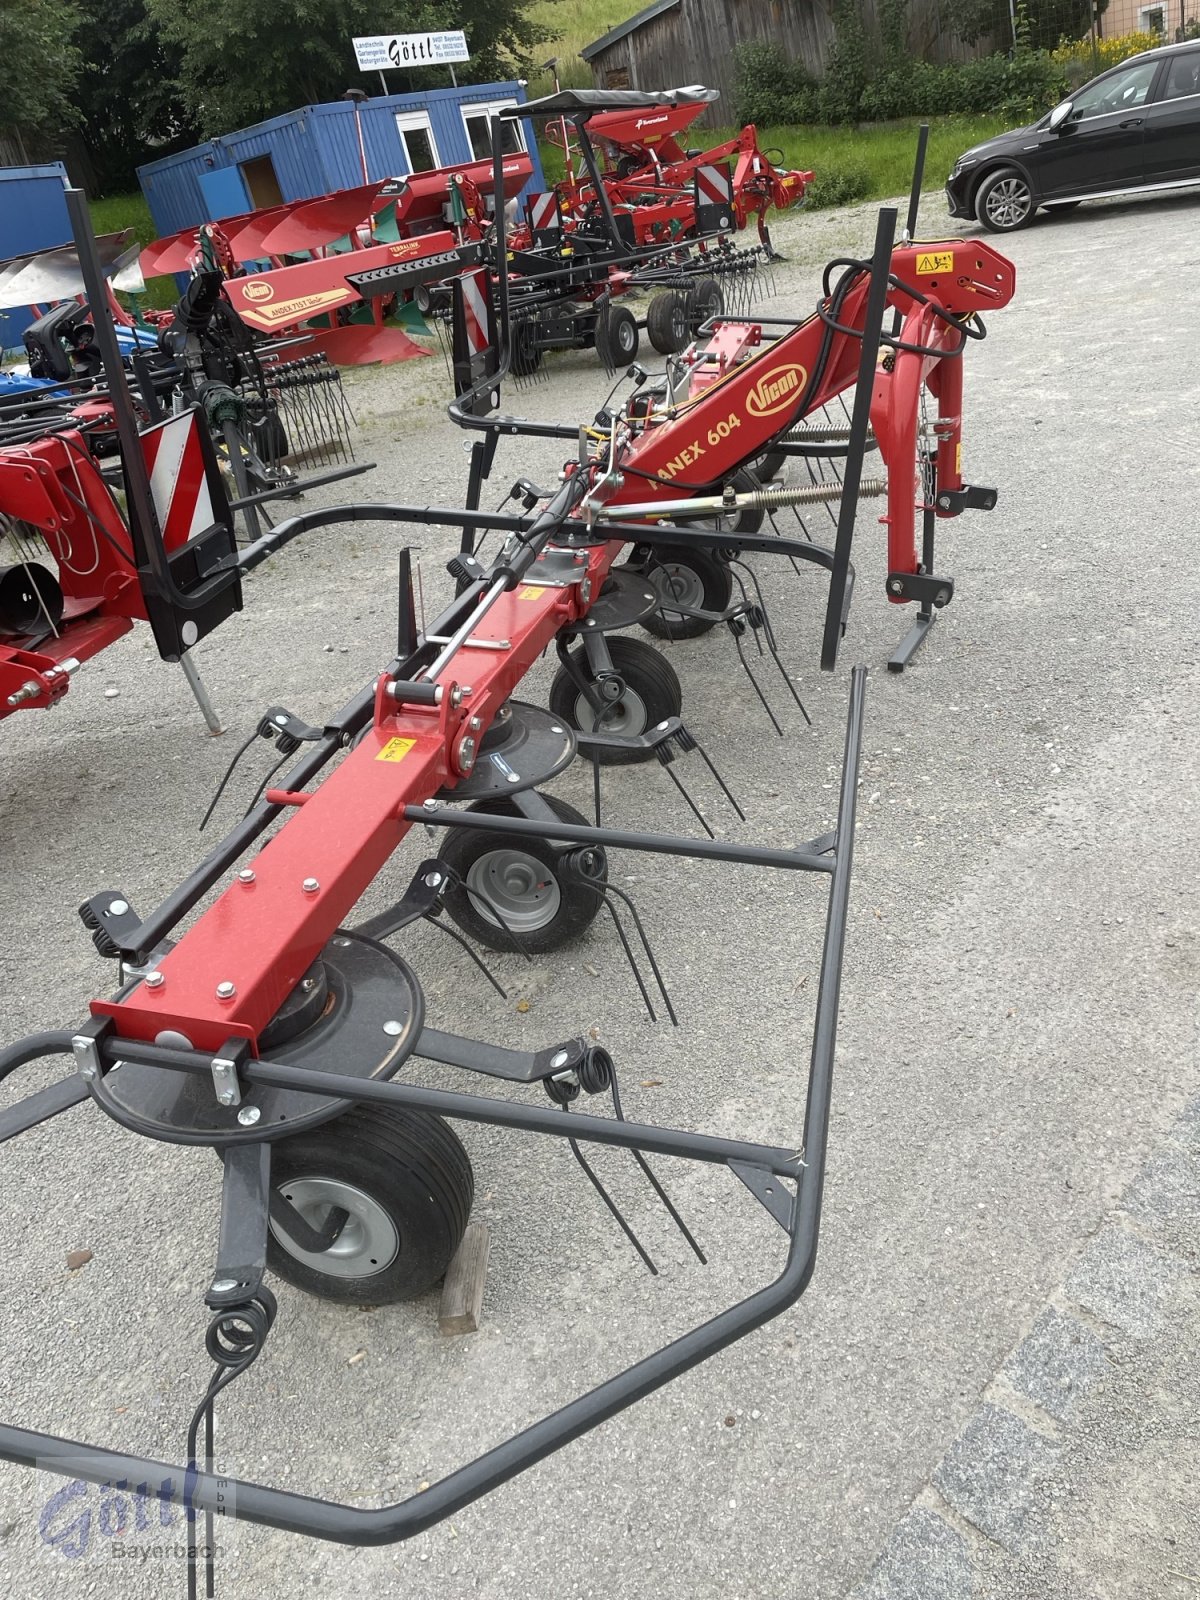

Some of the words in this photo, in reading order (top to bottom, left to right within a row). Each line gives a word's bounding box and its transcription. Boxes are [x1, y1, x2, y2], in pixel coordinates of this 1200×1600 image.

[358, 49, 386, 57] Gartengeräte
[388, 37, 433, 66] Göttl
[246, 282, 270, 298] Vicon
[271, 305, 292, 317] ANDEX
[751, 369, 799, 411] Vicon
[707, 413, 741, 446] 604
